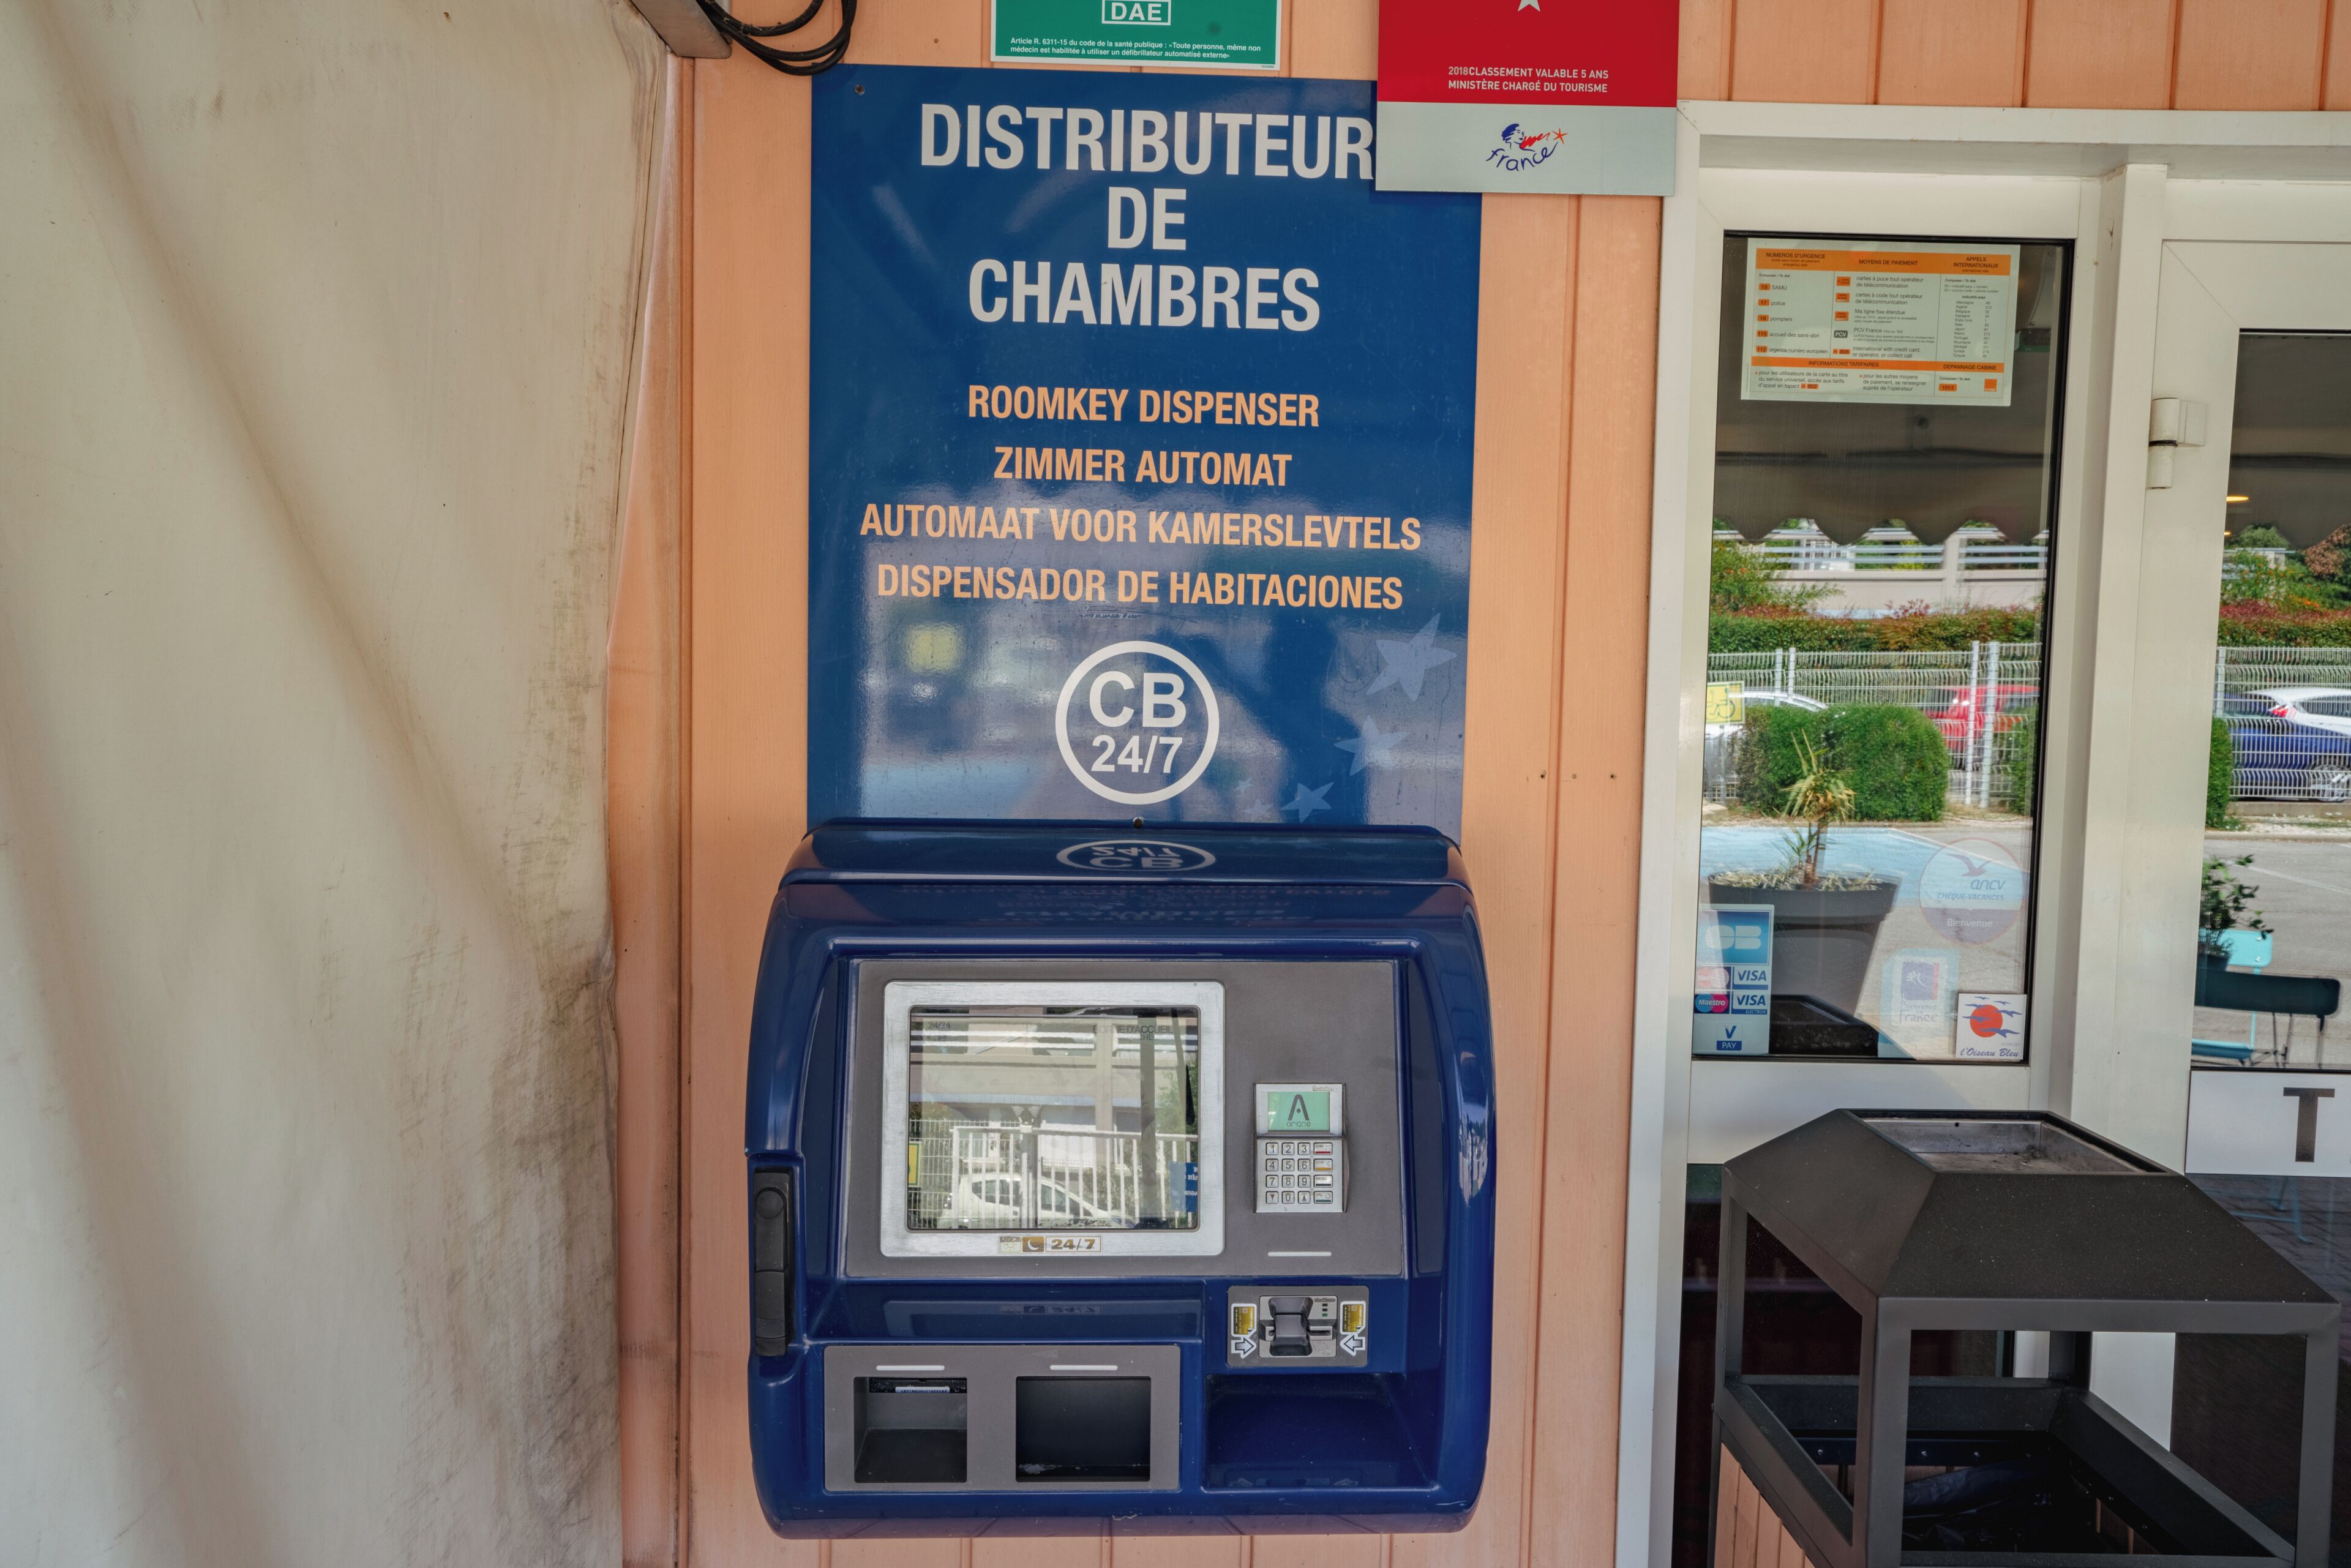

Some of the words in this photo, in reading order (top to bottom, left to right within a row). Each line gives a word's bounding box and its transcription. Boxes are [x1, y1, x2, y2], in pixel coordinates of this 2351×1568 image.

[1112, 2, 1161, 21] DAE
[1449, 79, 1499, 89] MINISTÈRE
[1502, 80, 1540, 91] CHARGÉ
[1560, 83, 1607, 92] TOURISME
[1535, 69, 1578, 78] VALABLE
[921, 104, 1374, 181] DISTRIBUTEUR
[1485, 141, 1559, 172] france
[1108, 186, 1186, 250] DE
[969, 259, 1319, 331] CHAMBRES
[969, 384, 1128, 422] ROOMKEY
[1139, 390, 1319, 426] DISPENSER
[995, 446, 1125, 481] ZIMMER
[1136, 451, 1291, 486] AUTOMAT
[860, 503, 1038, 539] AUTOMAAT
[1049, 508, 1136, 543] VOOR
[1149, 511, 1420, 550] KAMERSLEVTELS
[878, 564, 1106, 602] DISPENSADOR
[1119, 571, 1158, 602] DE
[1170, 571, 1402, 609] HABITACIONES
[1089, 671, 1187, 727] CB
[1091, 735, 1182, 773] 24/7
[1970, 879, 2006, 890] ancv
[1947, 918, 1993, 927] Bienvenue
[1738, 970, 1766, 981] VISA
[1737, 995, 1766, 1005] VISA
[1960, 1048, 1996, 1056] l'Oiseau
[2000, 1048, 2019, 1057] Bleu
[2283, 1088, 2335, 1163] T
[1051, 1239, 1095, 1250] 24/7
